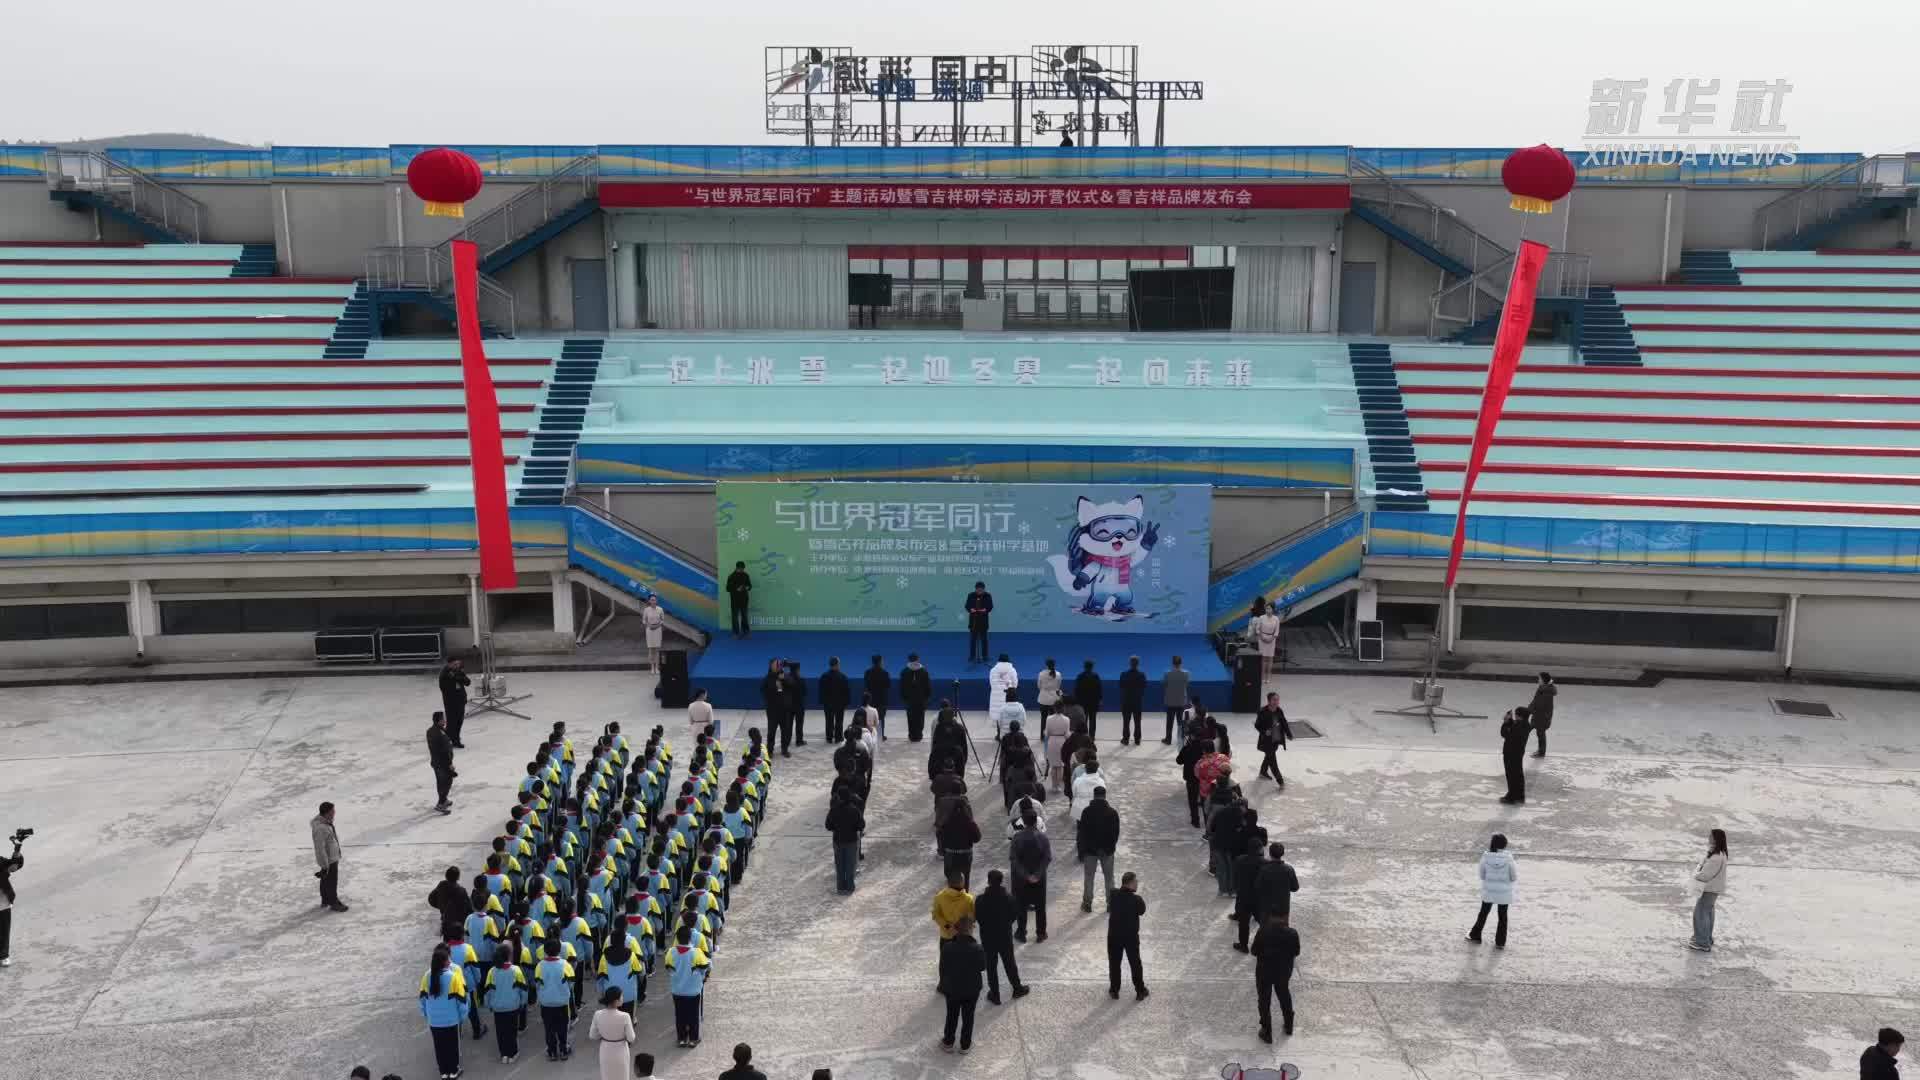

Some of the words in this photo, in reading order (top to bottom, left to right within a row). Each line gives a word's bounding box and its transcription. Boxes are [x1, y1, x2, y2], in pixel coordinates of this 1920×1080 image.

[1135, 82, 1202, 99] CHINA
[831, 188, 1253, 205] 主题活动暨雪吉祥研学活动开营仪式&雪吉祥品牌发布会
[775, 500, 1017, 533] 与世界冠军同行
